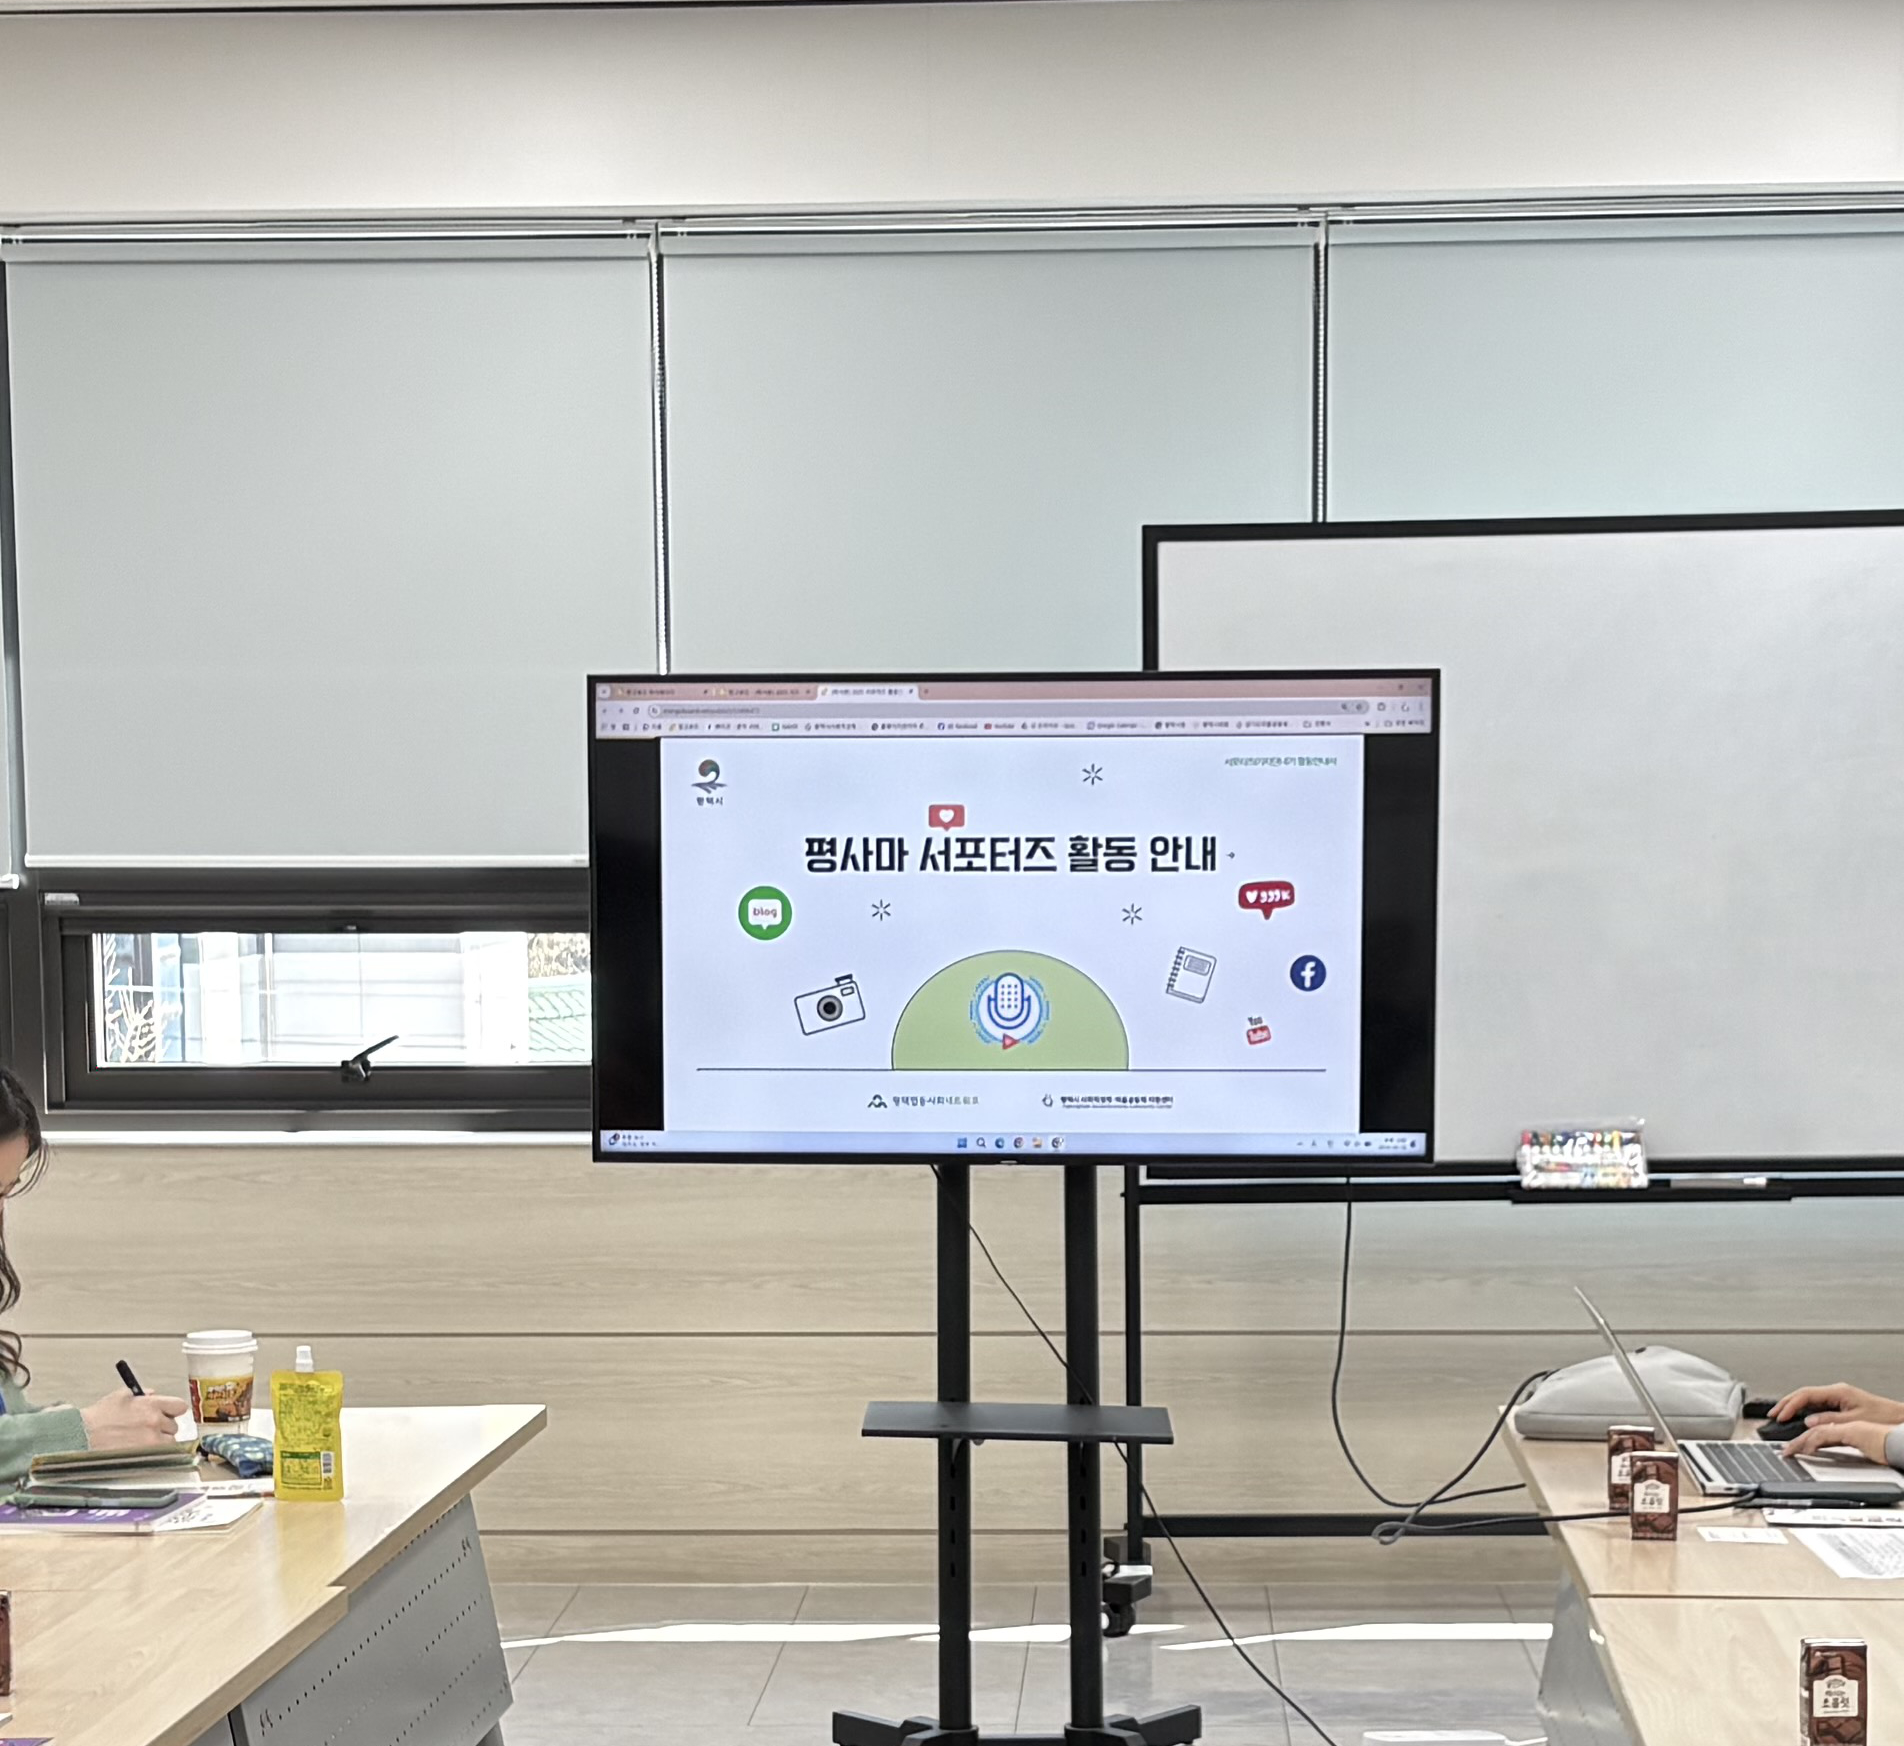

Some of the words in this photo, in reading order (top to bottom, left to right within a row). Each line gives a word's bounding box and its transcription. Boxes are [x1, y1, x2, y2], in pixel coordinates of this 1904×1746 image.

[804, 836, 910, 875] 평사마
[919, 836, 1058, 874] 서포터즈
[1067, 836, 1139, 874] 활동
[1149, 836, 1218, 874] 안내
[753, 906, 779, 919] blog
